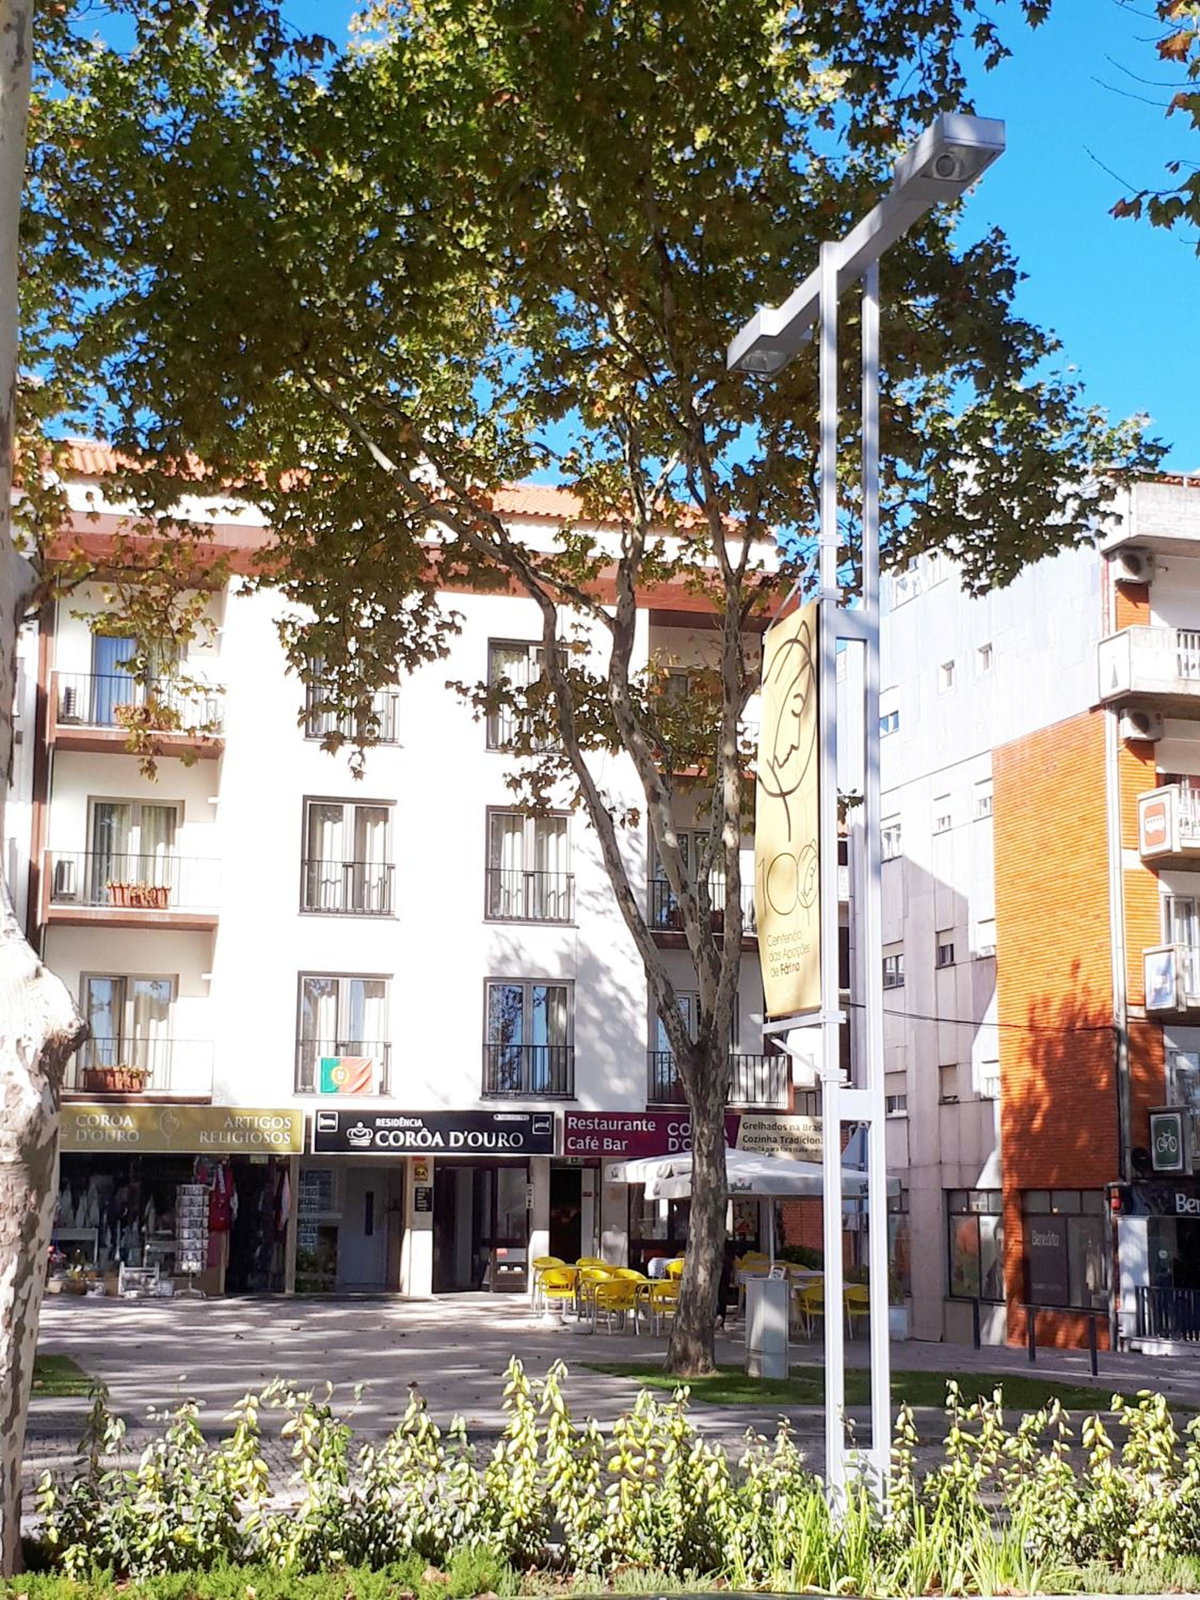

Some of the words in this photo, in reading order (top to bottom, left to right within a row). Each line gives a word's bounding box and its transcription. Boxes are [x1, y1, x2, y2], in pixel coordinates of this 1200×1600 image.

[780, 961, 801, 976] Fátima
[224, 1115, 292, 1130] ARTIGOS
[375, 1116, 423, 1128] RESIDÊNCIA
[567, 1116, 657, 1132] Restaurante
[742, 1121, 788, 1131] Grelhados
[789, 1123, 800, 1132] na
[802, 1123, 823, 1132] Bras
[76, 1128, 140, 1143] D'OURO
[199, 1130, 292, 1145] RELIGIOSOS
[375, 1128, 445, 1147] CORÔA
[449, 1130, 524, 1148] D'OURO
[742, 1134, 778, 1144] Cozinha
[779, 1135, 823, 1145] Tradicion
[567, 1136, 600, 1150] Café
[603, 1137, 629, 1151] Bar
